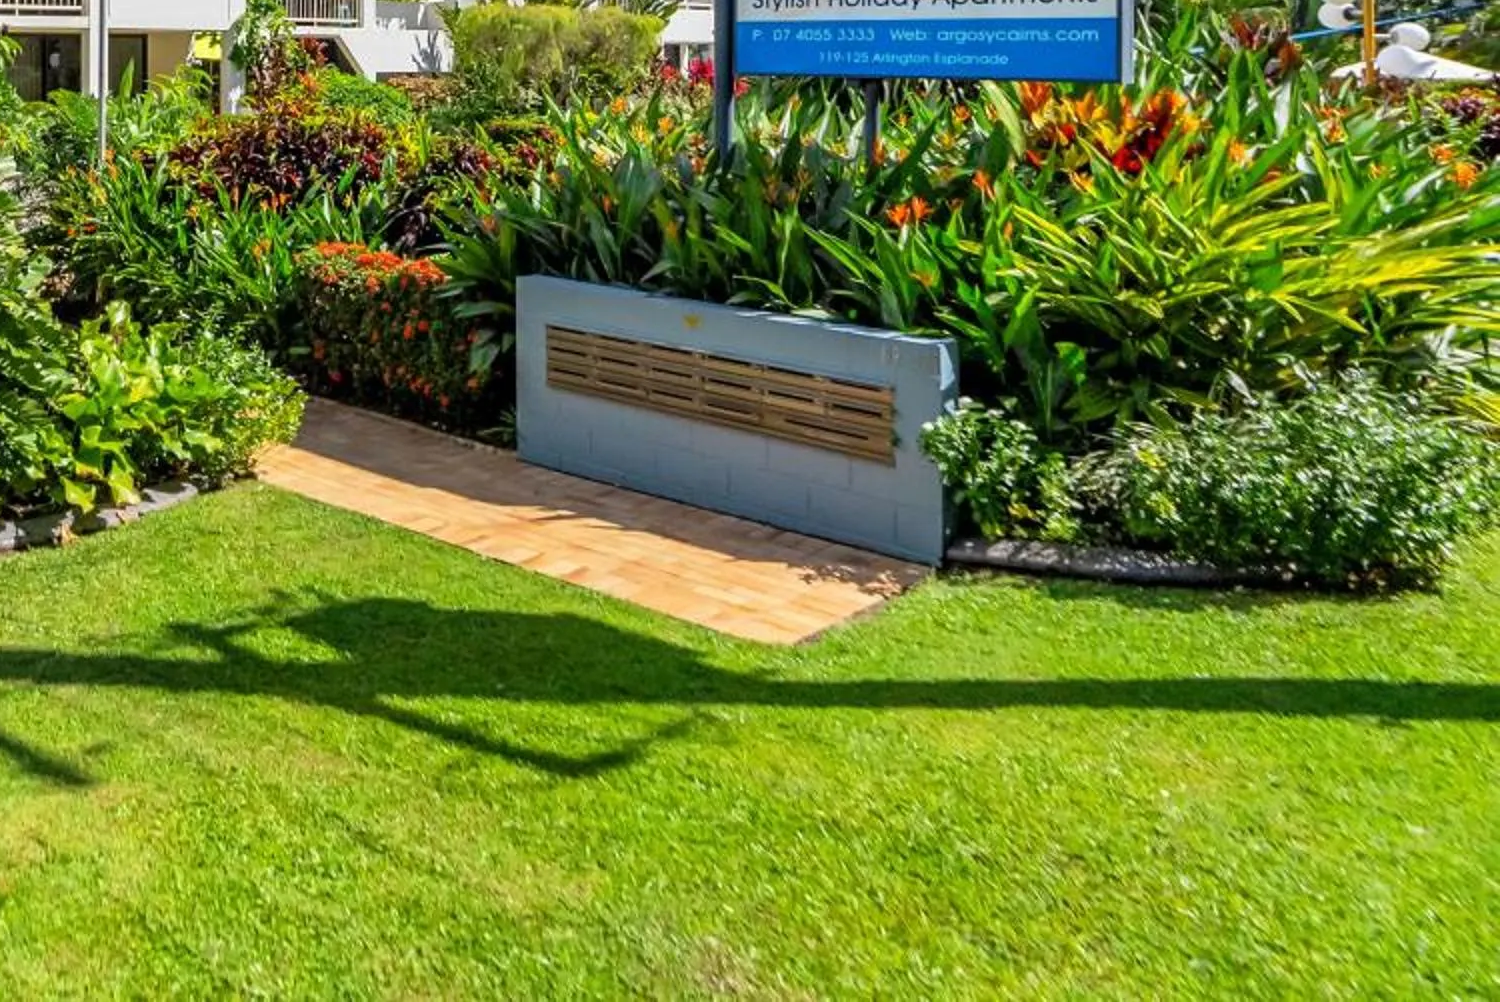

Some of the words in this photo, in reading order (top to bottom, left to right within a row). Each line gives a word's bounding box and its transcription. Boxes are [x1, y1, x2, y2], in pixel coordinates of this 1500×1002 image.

[772, 28, 790, 42] 07
[795, 28, 833, 42] 4055
[837, 27, 876, 42] 3333
[933, 52, 1010, 66] Esplanade
